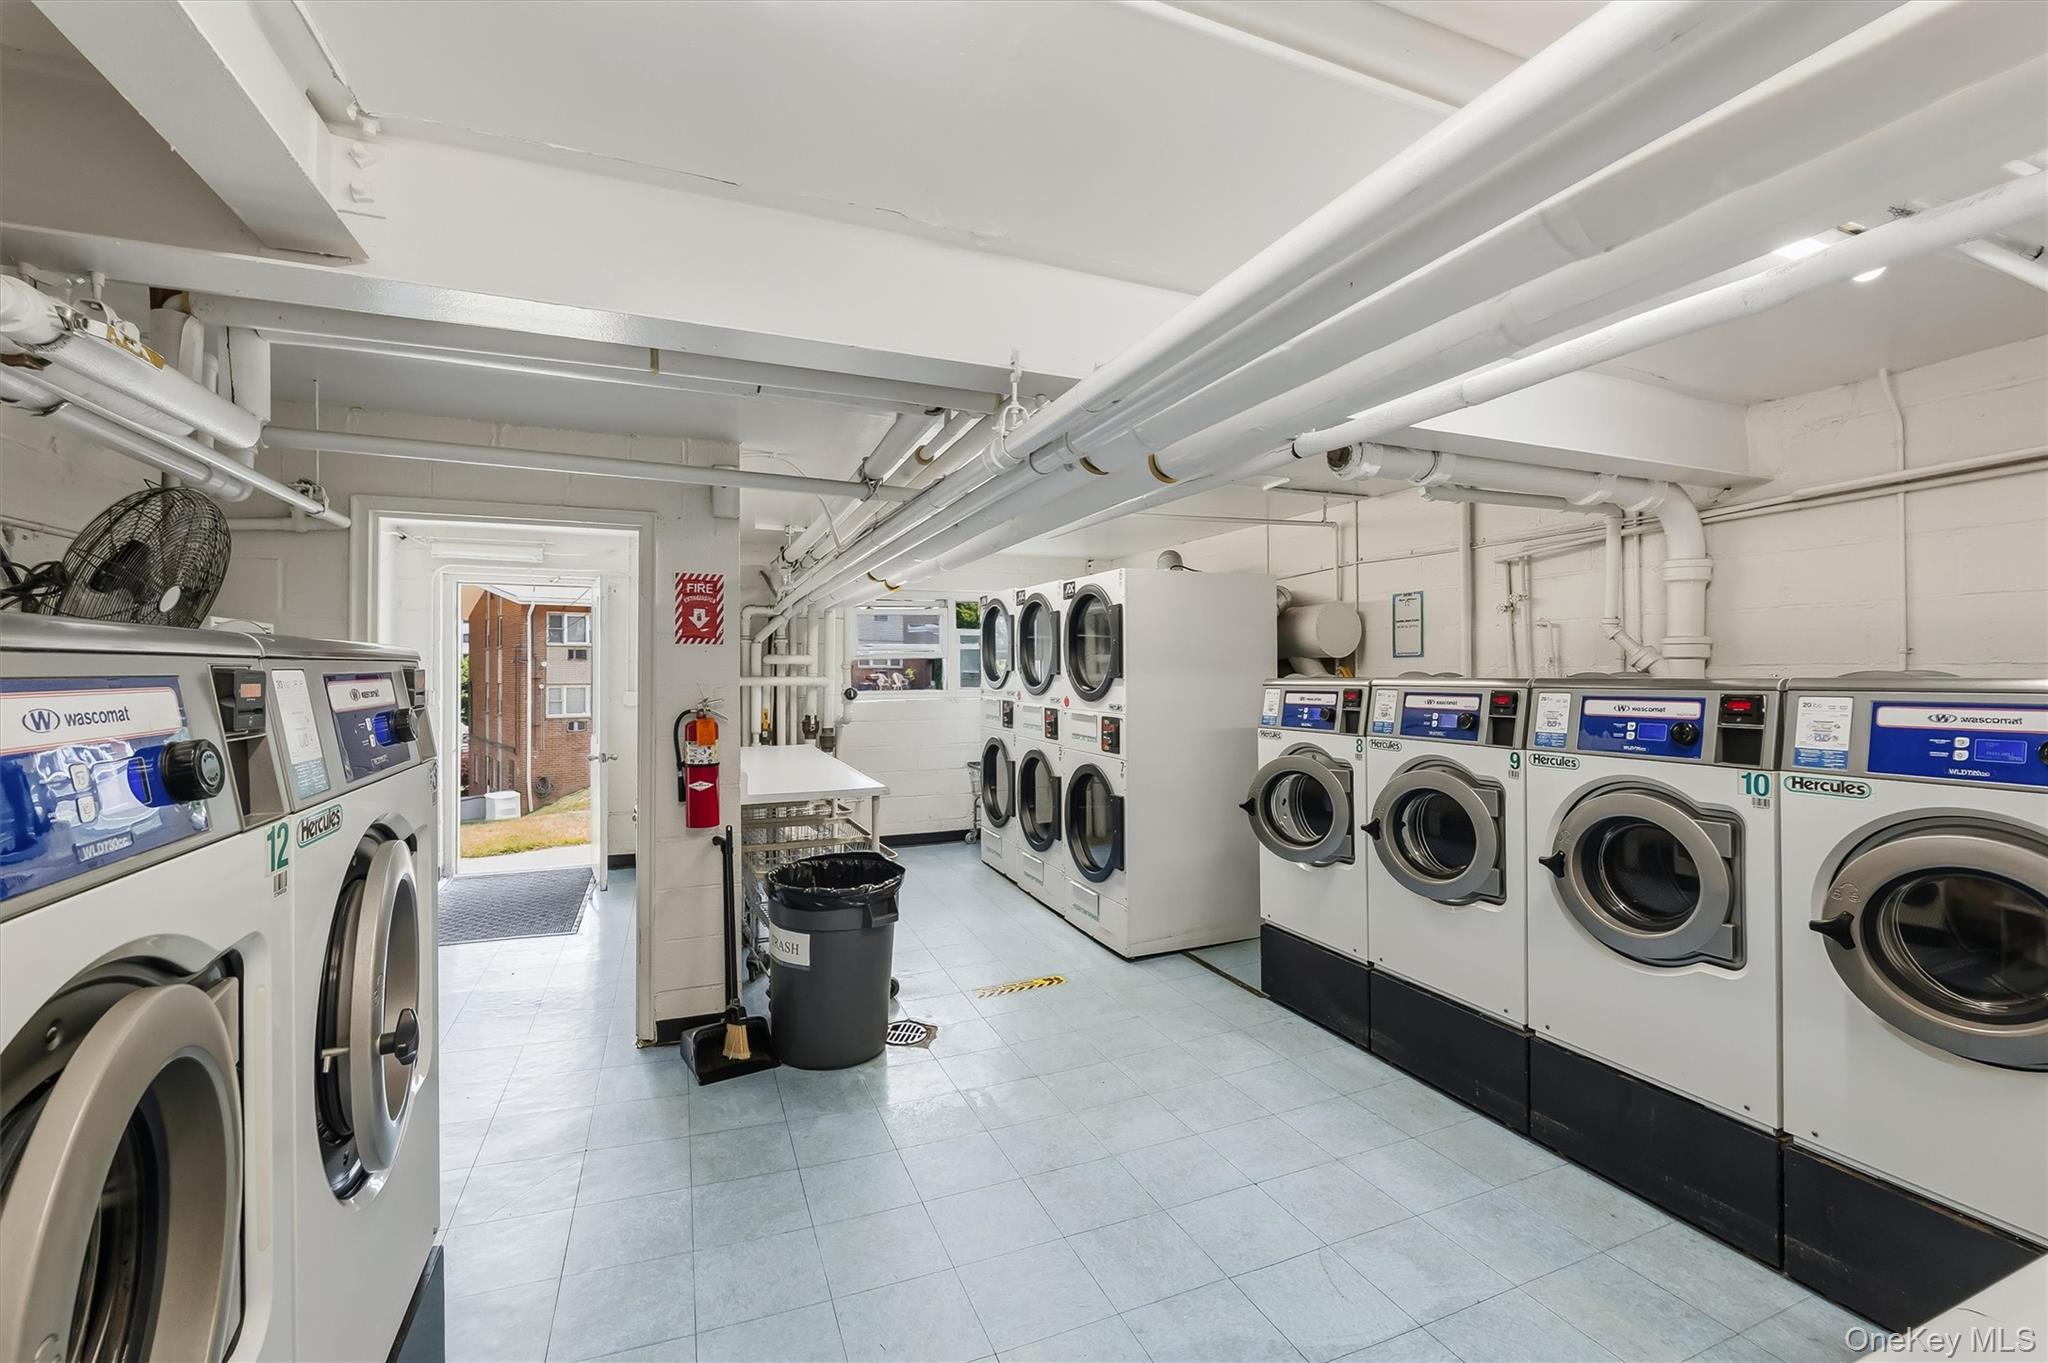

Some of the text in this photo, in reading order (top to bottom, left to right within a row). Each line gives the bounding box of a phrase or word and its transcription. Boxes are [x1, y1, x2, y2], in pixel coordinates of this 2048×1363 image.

[686, 583, 713, 594] FIRE
[31, 706, 130, 730] W wascomat
[1960, 716, 2023, 726] wascomat
[1356, 738, 1363, 753] 8
[1371, 739, 1400, 750] Hercules
[1510, 752, 1521, 770] 9
[1533, 754, 1577, 768] Hercules
[1742, 772, 1770, 797] 10
[1791, 776, 1866, 796] Hercules
[300, 807, 341, 841] Hercules
[267, 822, 289, 873] 12
